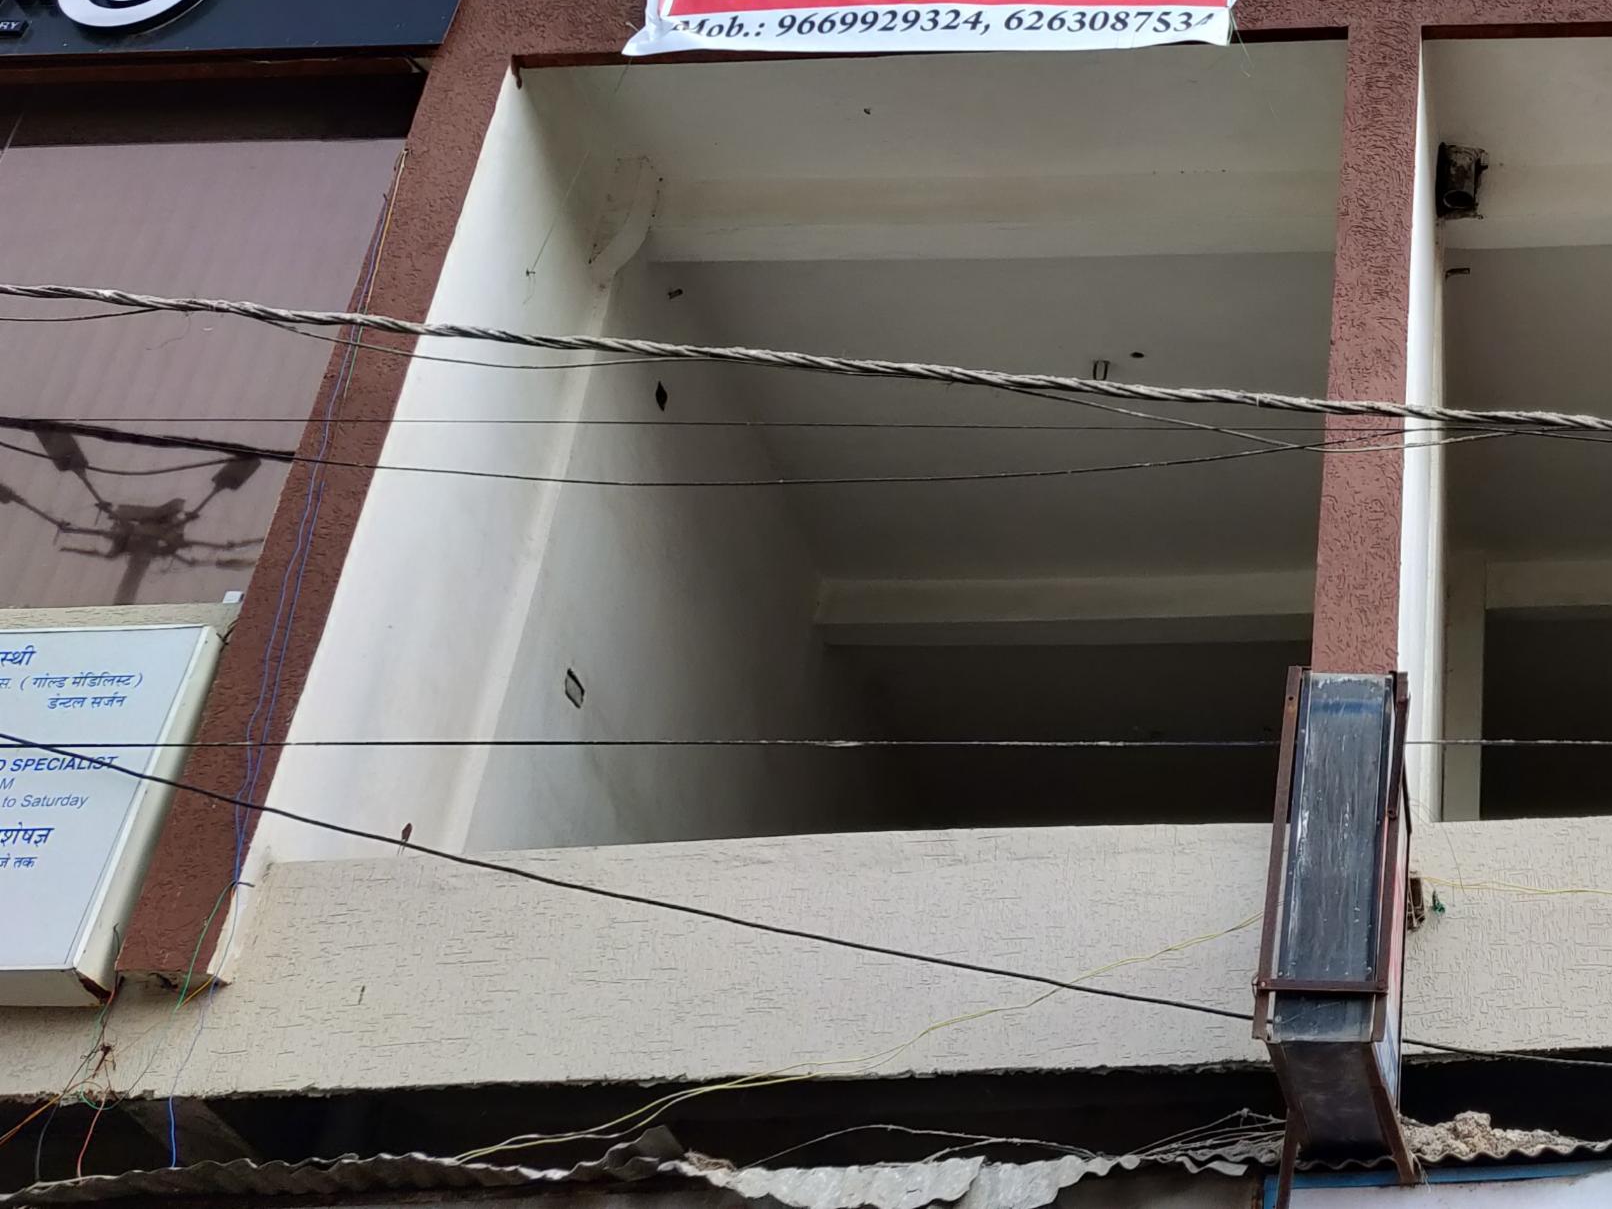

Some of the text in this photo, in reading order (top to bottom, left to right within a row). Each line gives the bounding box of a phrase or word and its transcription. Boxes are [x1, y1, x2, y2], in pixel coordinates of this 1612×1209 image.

[775, 9, 991, 37] 9669929324,
[91, 692, 127, 708] सर्जन
[10, 756, 118, 771] SPECIALIST
[2, 793, 89, 810] to Saturday
[13, 856, 38, 869] तक
